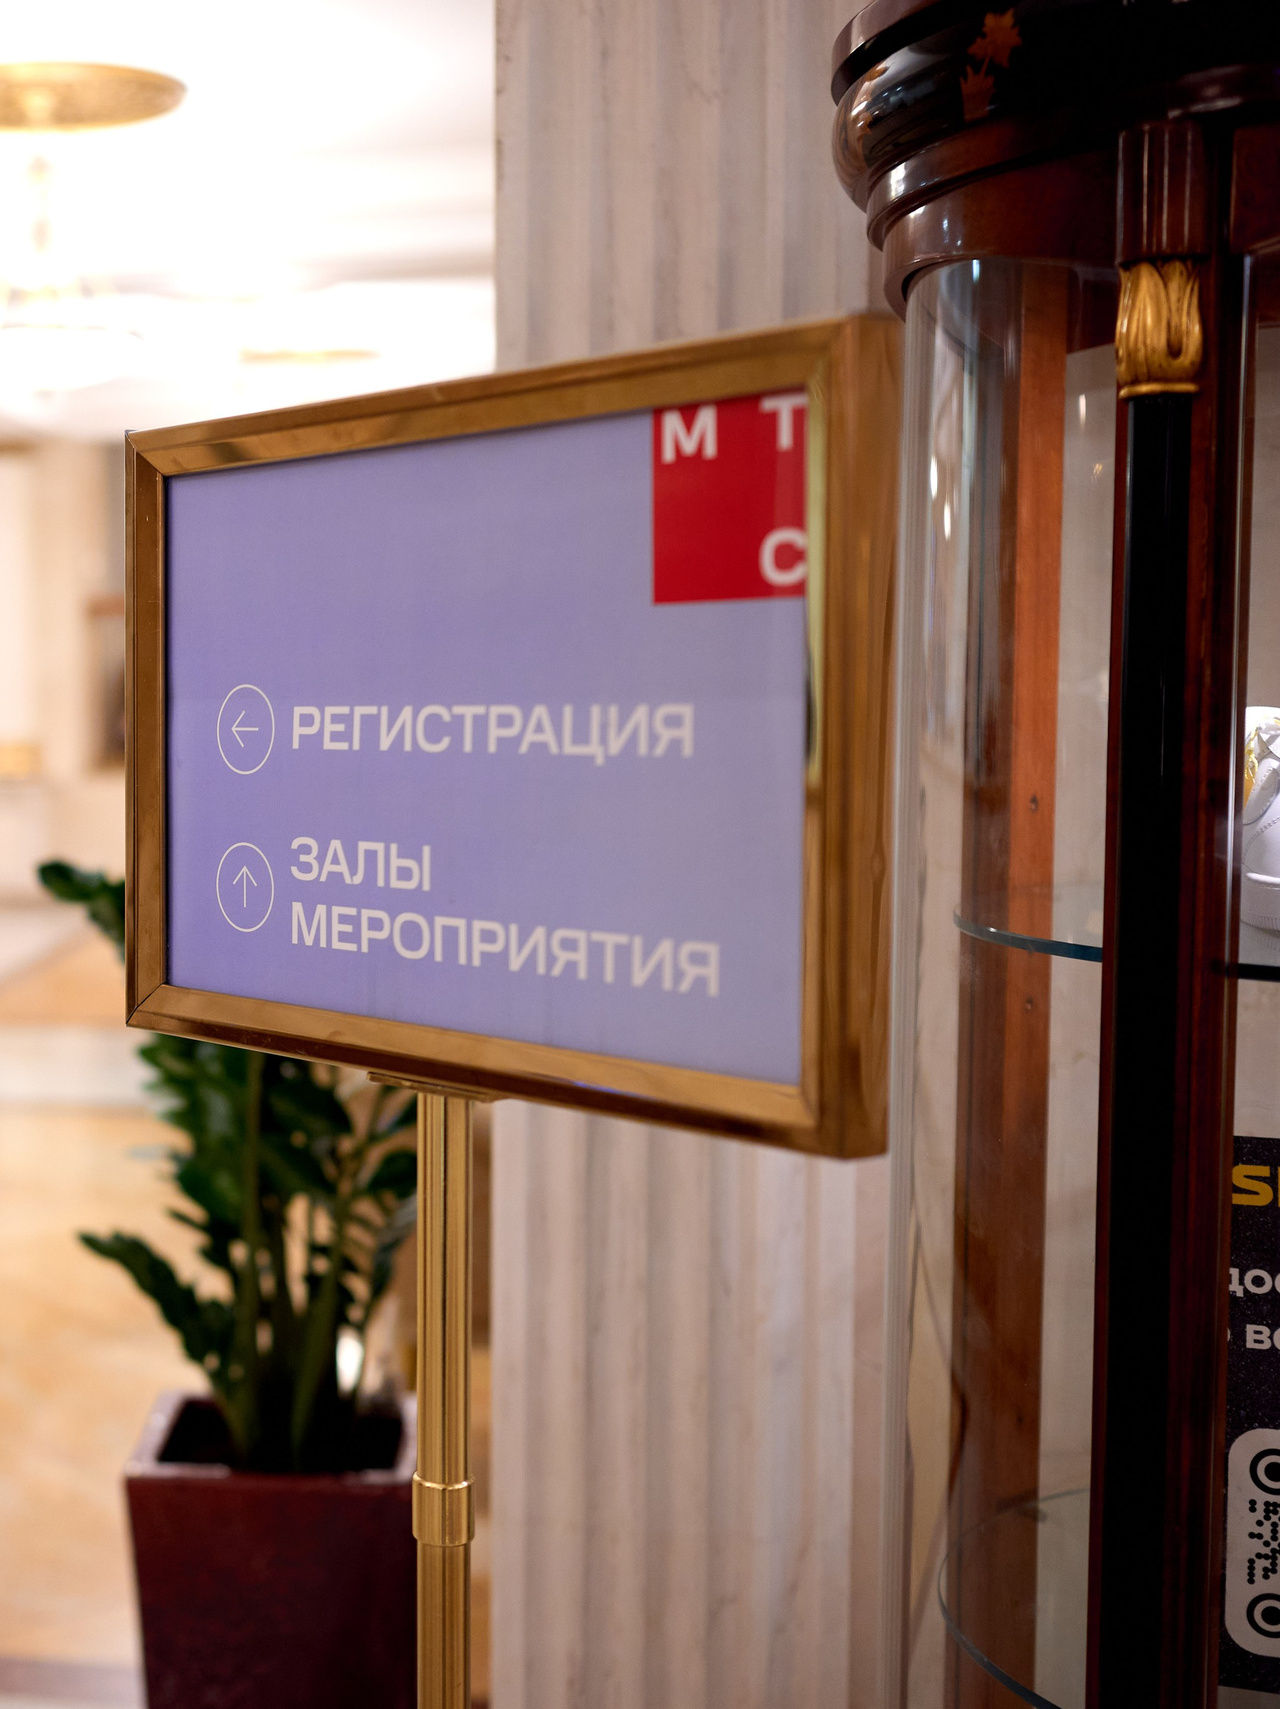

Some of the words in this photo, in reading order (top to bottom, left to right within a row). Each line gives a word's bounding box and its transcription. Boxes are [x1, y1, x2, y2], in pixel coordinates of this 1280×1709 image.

[290, 704, 695, 765] РЕГИСТРАЦИЯ
[289, 836, 432, 891] ЗАЛЫ
[290, 901, 720, 997] МЕРОПРИЯТИЯ
[1231, 1164, 1280, 1208] S
